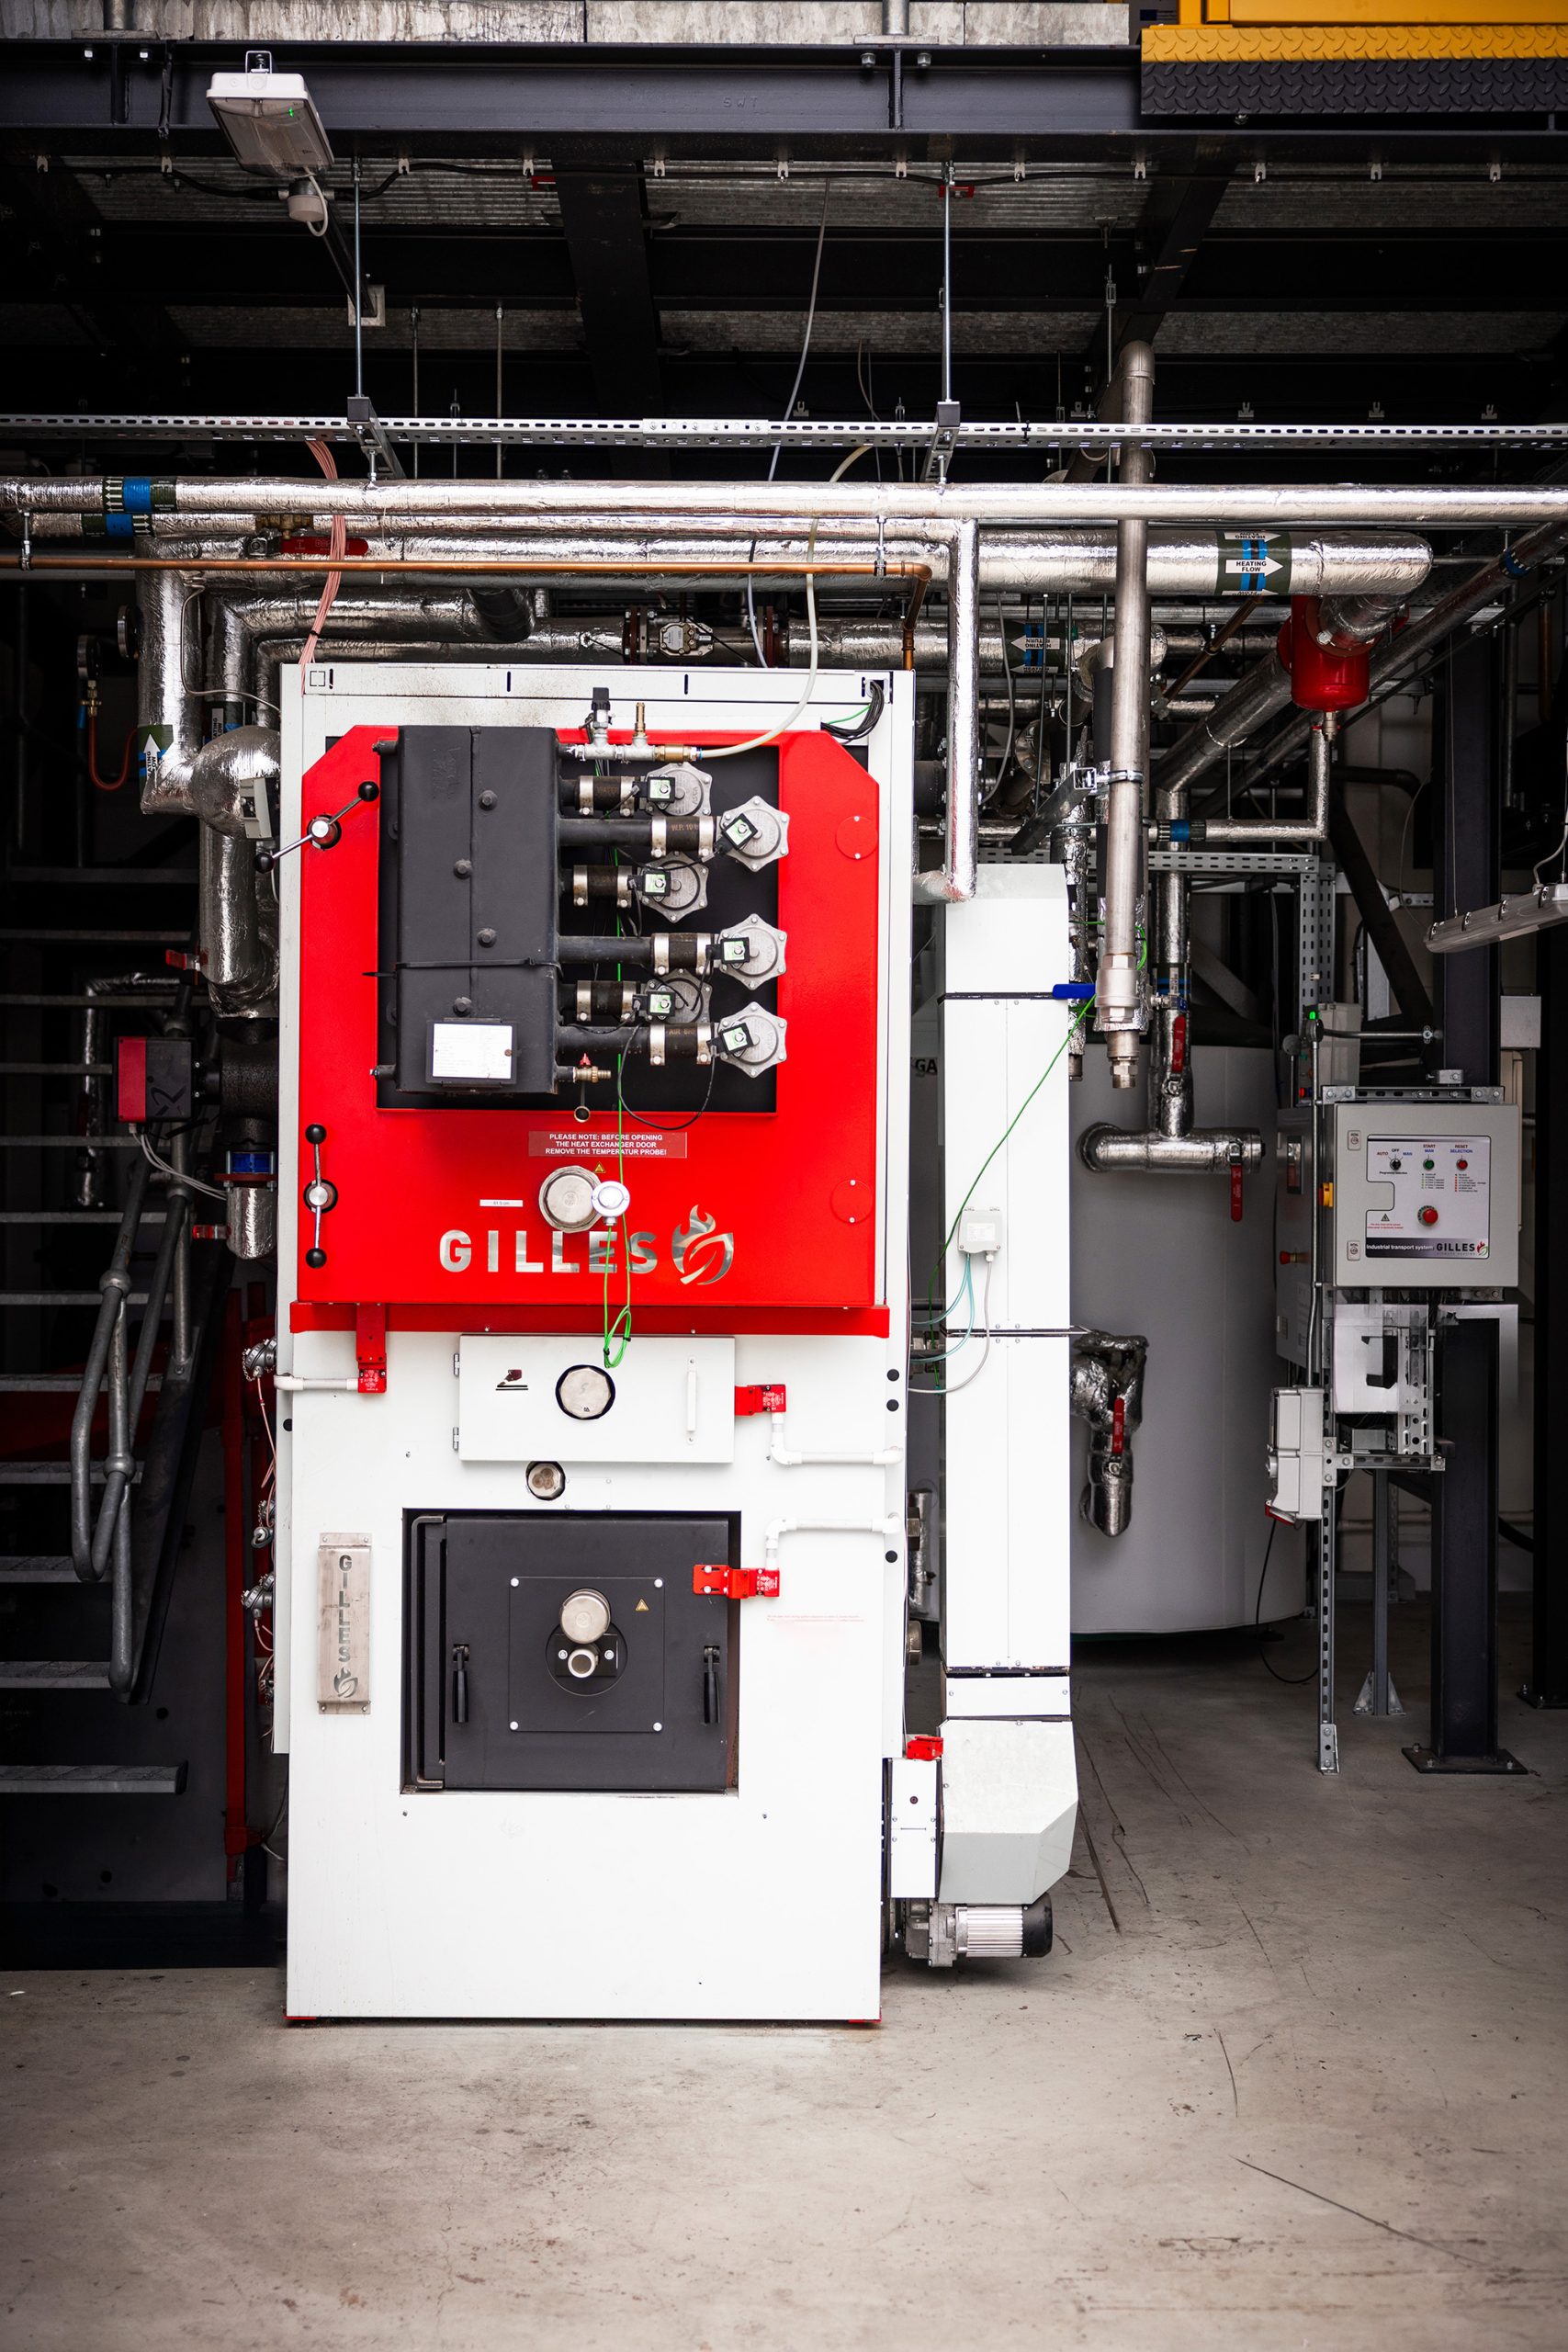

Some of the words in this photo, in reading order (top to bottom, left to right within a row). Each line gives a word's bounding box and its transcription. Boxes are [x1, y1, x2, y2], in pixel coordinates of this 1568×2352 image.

[439, 1229, 658, 1273] GILLES
[1436, 1242, 1475, 1251] GILLES
[338, 1555, 352, 1662] GILLES
